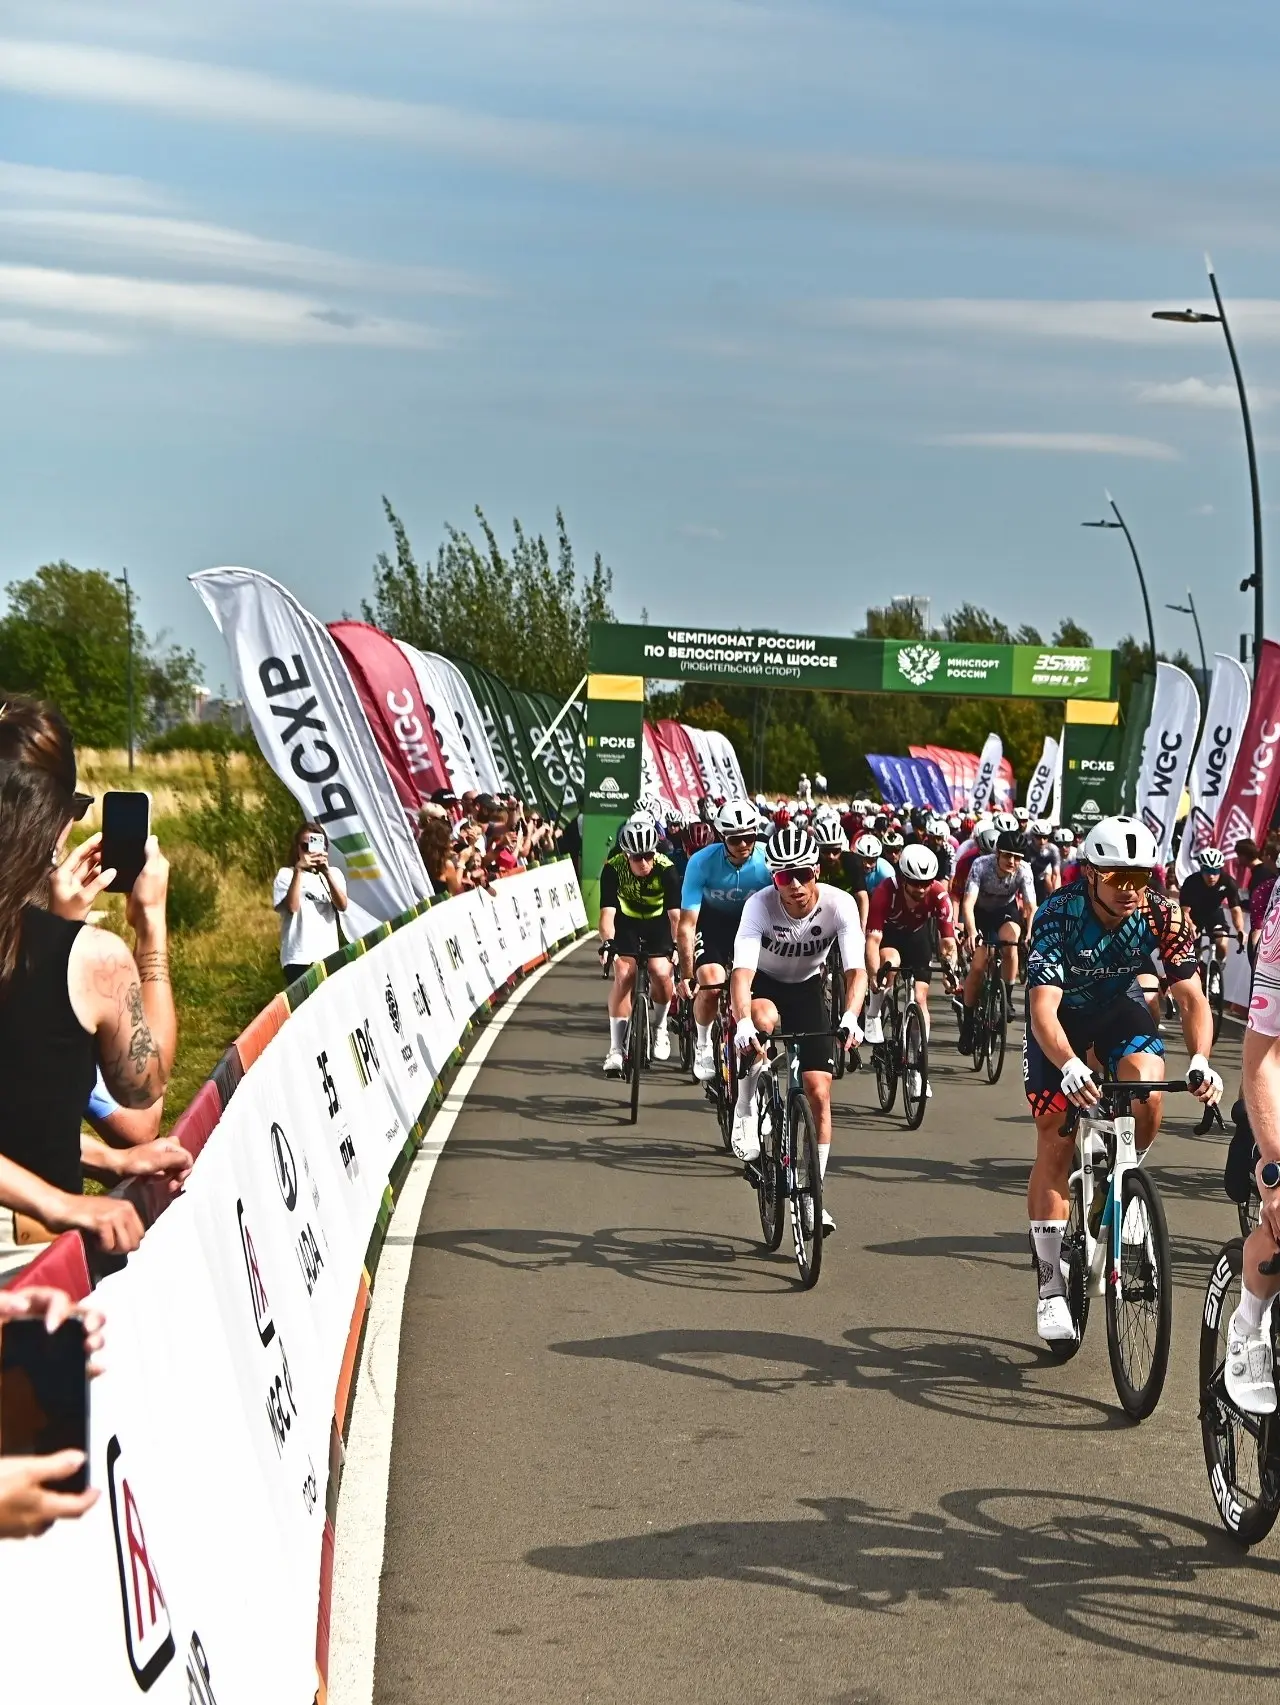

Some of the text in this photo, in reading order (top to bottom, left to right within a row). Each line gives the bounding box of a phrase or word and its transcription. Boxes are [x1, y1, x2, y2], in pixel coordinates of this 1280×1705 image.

[667, 630, 816, 651] ЧЕМПИОНАТ РОССИИ
[644, 644, 838, 668] ПО ВЕЛОСПОРТУ НА ШОССЕ
[680, 660, 801, 679] (ЛЮБИТЕЛЬСКИЙ СПОРТ)
[947, 657, 1000, 669] МИНСПОРТ
[946, 669, 987, 680] РОССИИ
[599, 736, 636, 749] РСХБ
[1081, 759, 1115, 772] РСХБ
